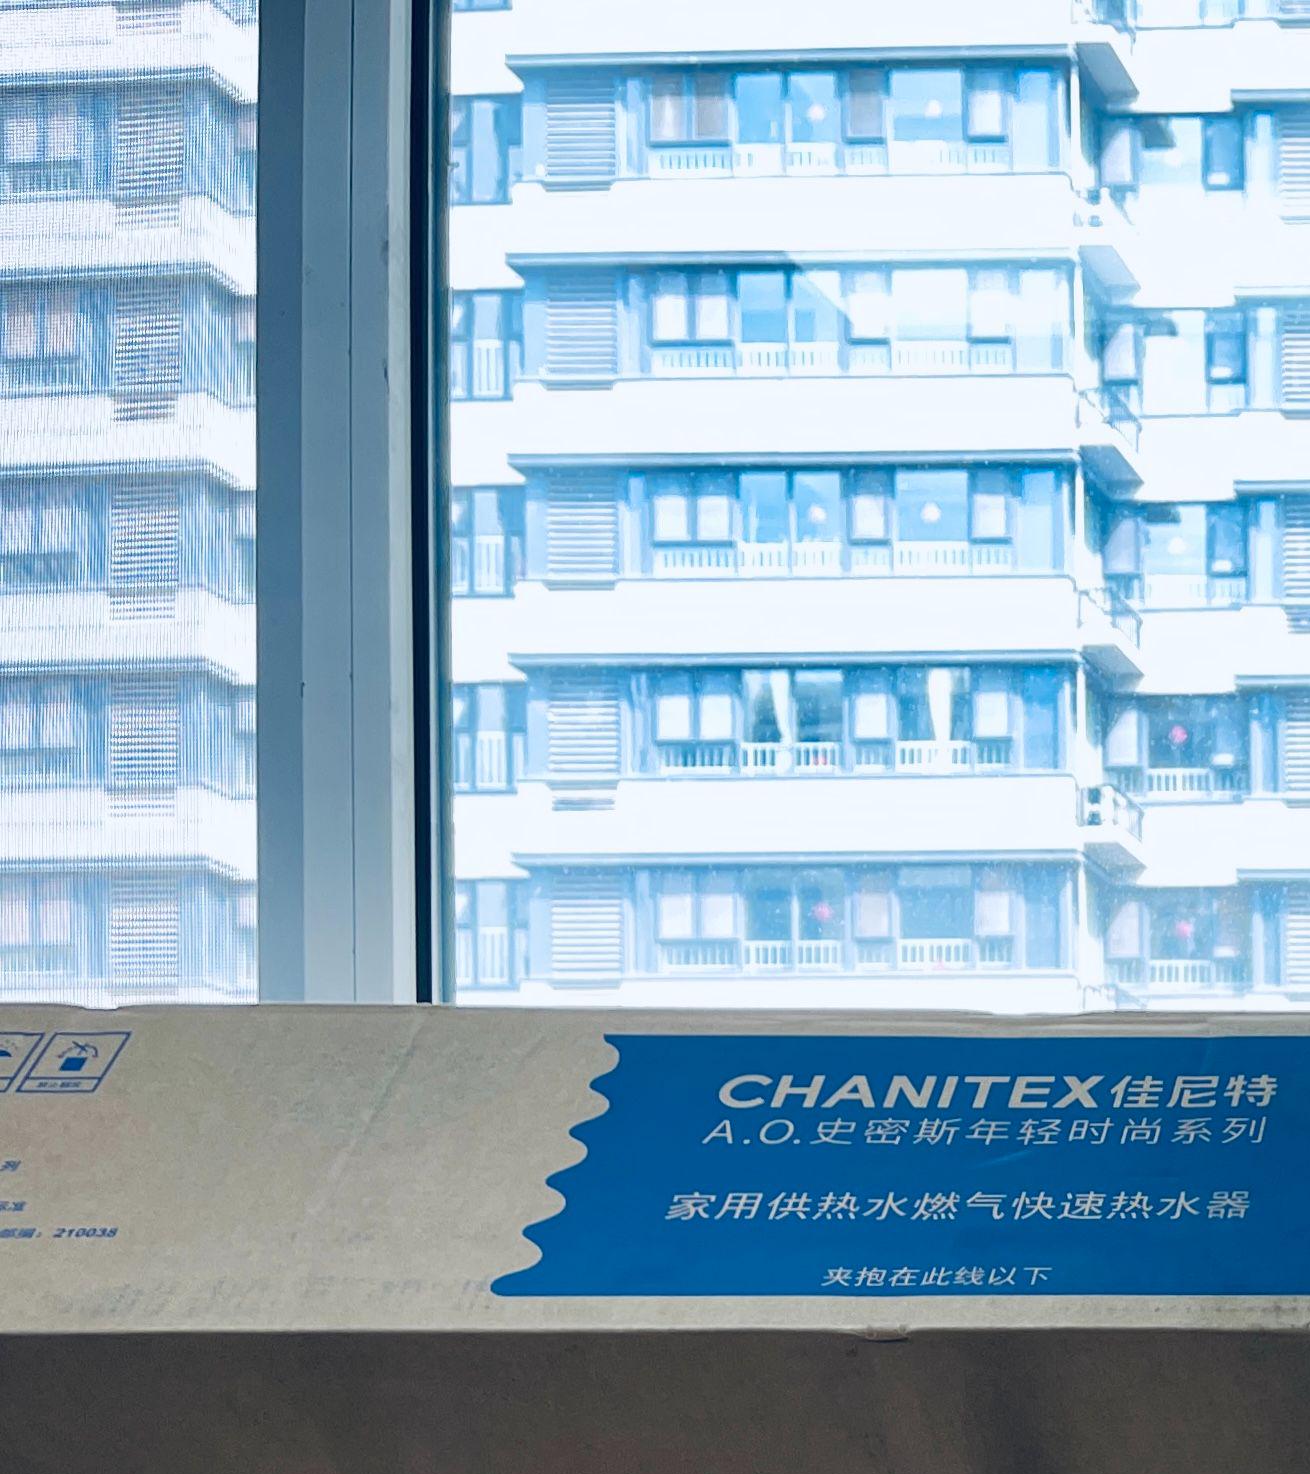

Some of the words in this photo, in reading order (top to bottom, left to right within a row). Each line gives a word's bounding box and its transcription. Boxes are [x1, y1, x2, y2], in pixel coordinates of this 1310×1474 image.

[701, 1116, 1267, 1146] A.O.史密斯年轻时尚系列
[664, 1191, 1250, 1220] 家用供热水燃气快速热水器
[820, 1266, 1053, 1287] 夹抱在此线以下
